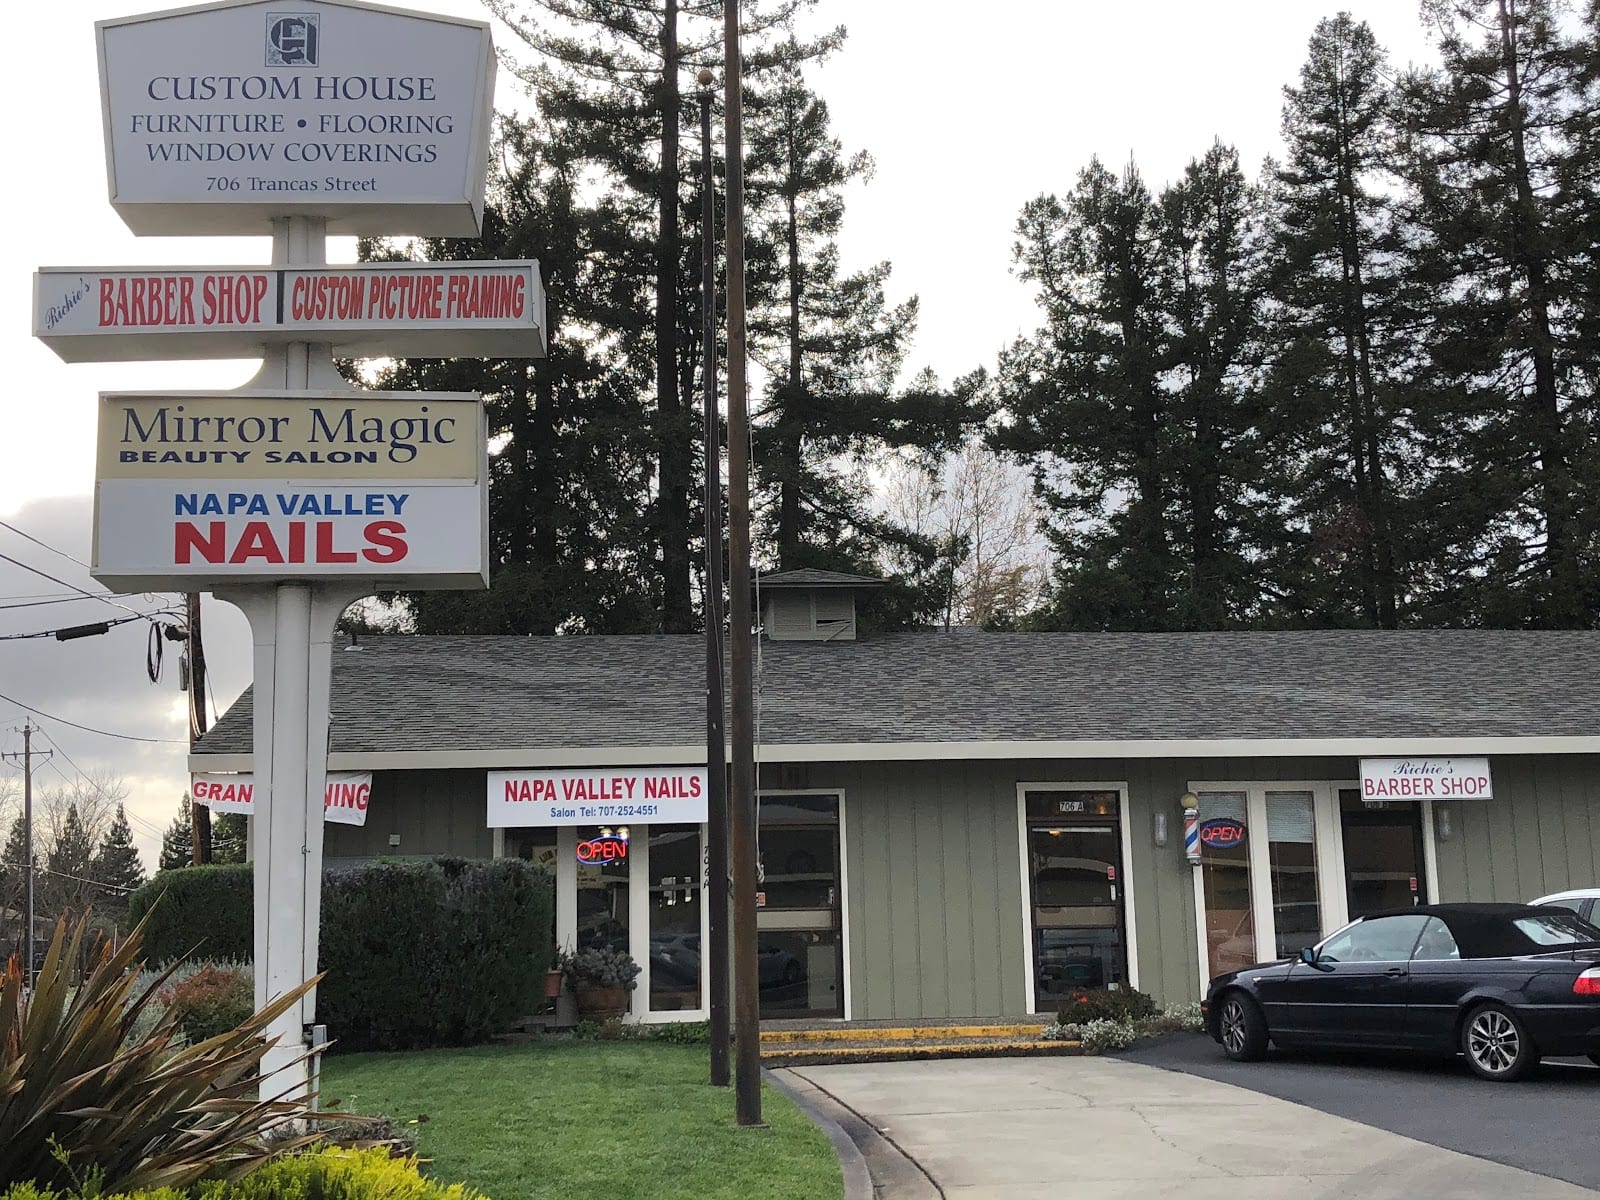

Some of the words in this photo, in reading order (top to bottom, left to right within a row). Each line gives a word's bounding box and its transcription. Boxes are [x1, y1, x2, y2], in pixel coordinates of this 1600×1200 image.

[147, 76, 302, 101] CUSTOM
[315, 77, 436, 101] HOUSE
[130, 114, 285, 133] FURNITURE
[318, 115, 454, 134] FLOORING
[146, 143, 274, 162] WINDOW
[284, 143, 437, 163] COVERINGS
[206, 176, 241, 192] 706
[247, 176, 319, 192] Trancas
[324, 176, 377, 192] Street
[45, 277, 91, 330] Richie's
[98, 276, 196, 327] BARBER
[202, 274, 268, 324] SHOP
[291, 275, 365, 321] CUSTOM
[367, 275, 444, 320] PICTURE
[446, 274, 525, 319] FRAMING
[120, 406, 290, 443] Mirror
[309, 406, 456, 464] Magic
[119, 451, 251, 463] BEAUTY
[265, 451, 377, 463] SALON
[175, 494, 268, 516] NAPA
[276, 494, 409, 516] VALLEY
[174, 521, 409, 564] NAILS
[1393, 760, 1454, 775] Richie's
[193, 781, 254, 803] GRAN
[504, 779, 558, 802] NAPA
[562, 777, 637, 800] VALLEY
[644, 775, 701, 798] NAILS
[1364, 777, 1436, 796] BARBER
[1440, 776, 1488, 795] SHOP
[550, 807, 576, 818] Salon
[580, 806, 597, 817] Tel:
[598, 804, 658, 817] 707-252-4551
[1201, 826, 1244, 842] OPEN
[576, 841, 627, 860] OPEN
